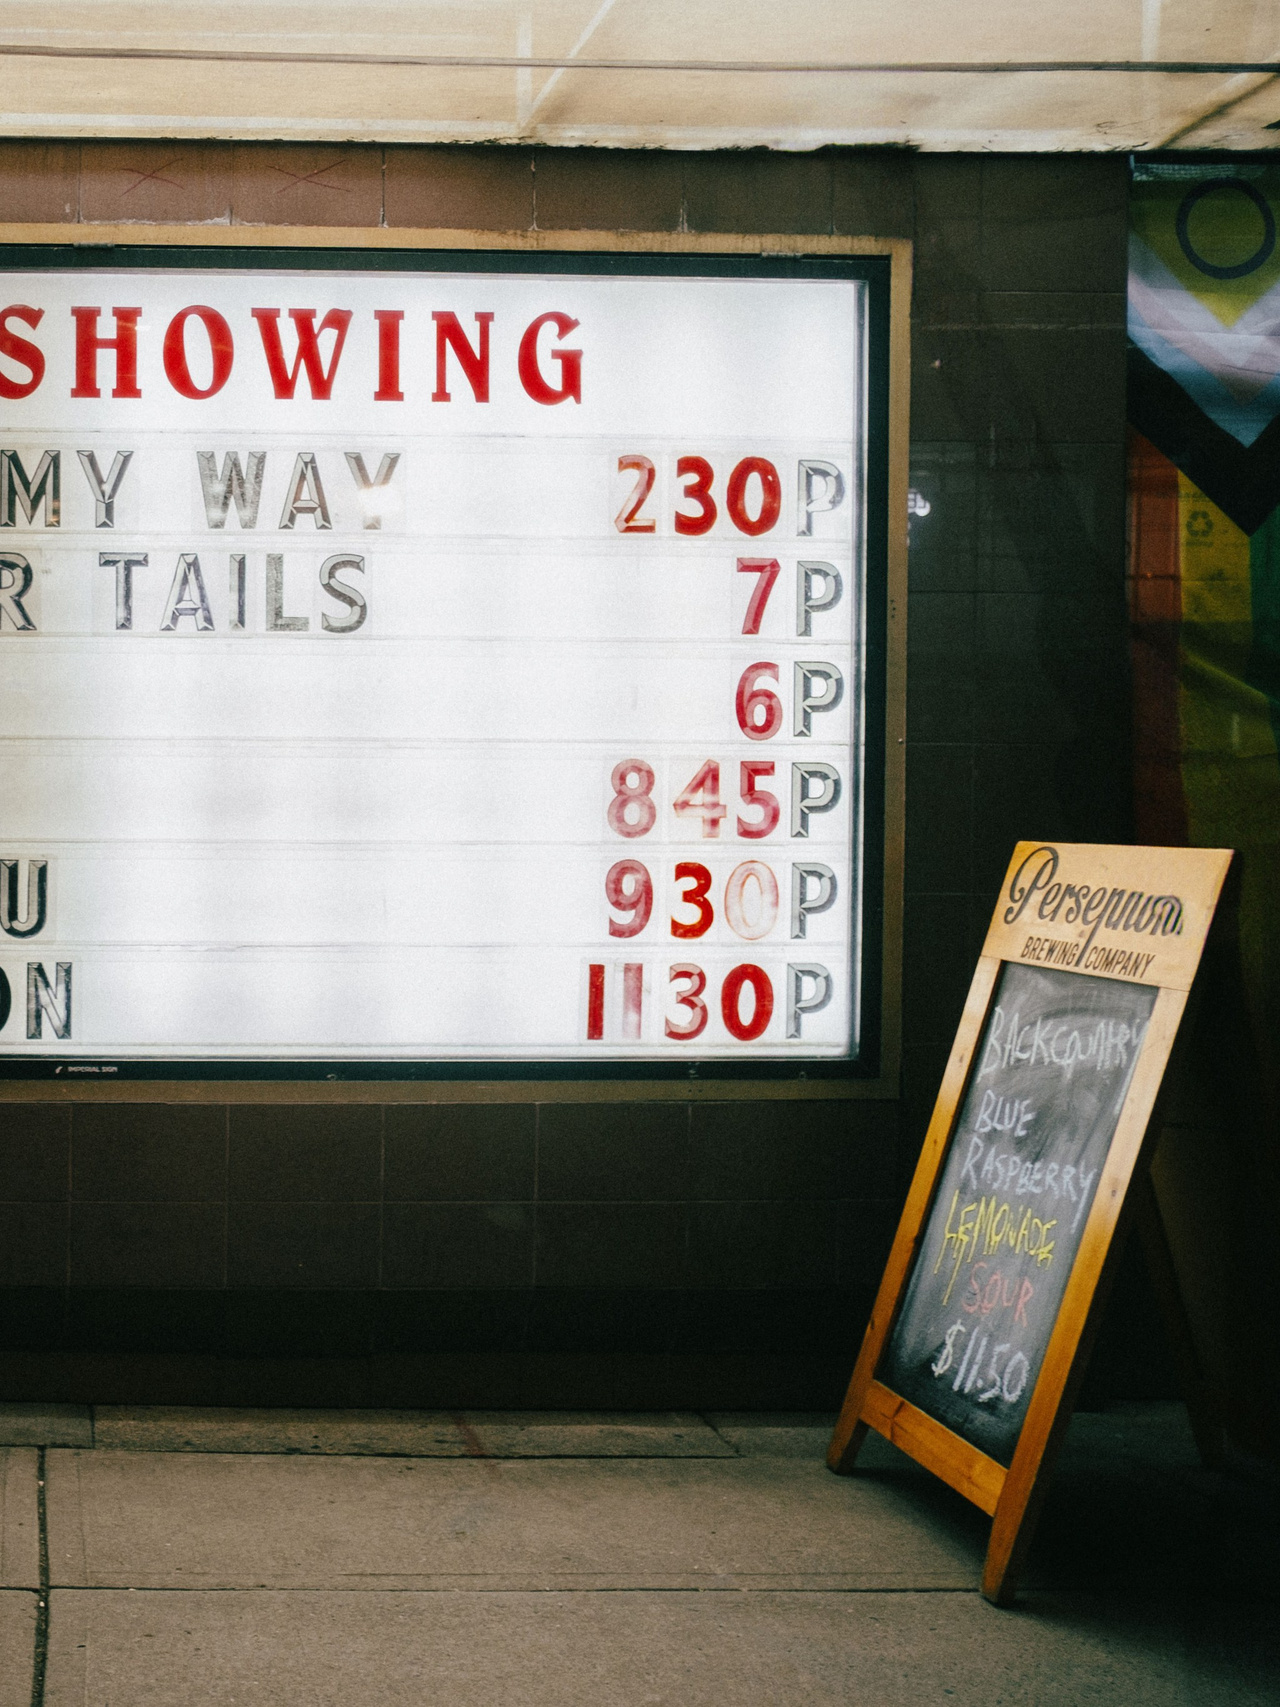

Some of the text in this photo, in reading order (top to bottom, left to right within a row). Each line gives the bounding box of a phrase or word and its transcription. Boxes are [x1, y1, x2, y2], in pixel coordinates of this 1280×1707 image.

[0, 448, 135, 529] MY
[196, 450, 402, 531] WAY
[613, 454, 847, 538] 230P
[98, 551, 368, 634] TAILS
[735, 556, 844, 638] 7P
[734, 660, 845, 742] 6P
[607, 757, 843, 840] 845P
[1020, 936, 1156, 979] BREWING COMPANY
[975, 1089, 1037, 1138] BLUE
[961, 1136, 1098, 1235] RASPBERRY
[934, 1189, 1058, 1306] LEMONADE
[961, 1260, 1035, 1329] SOUR
[931, 1318, 1031, 1404] $11.50
